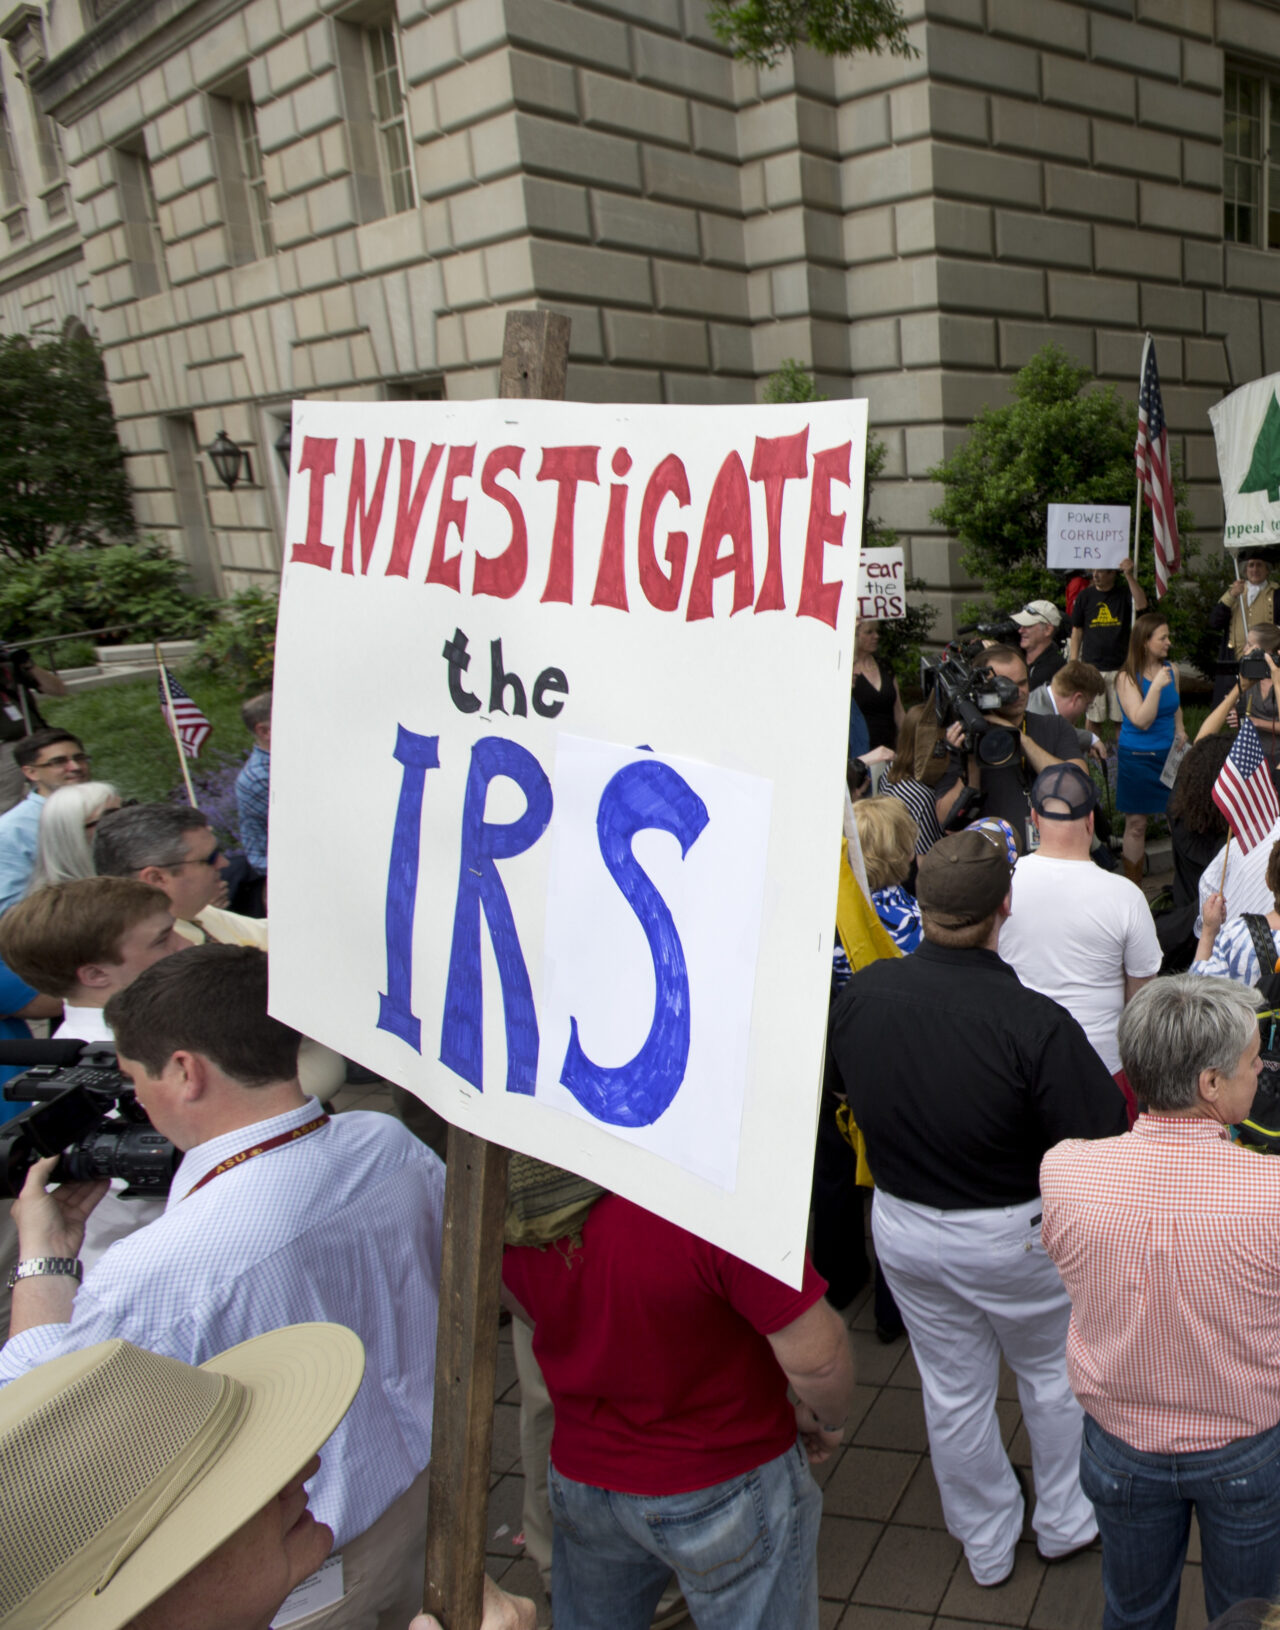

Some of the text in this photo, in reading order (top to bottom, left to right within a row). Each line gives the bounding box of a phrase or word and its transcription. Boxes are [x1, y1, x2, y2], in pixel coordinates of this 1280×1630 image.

[1067, 511, 1111, 524] POWER
[1060, 529, 1125, 542] CORRUPTS
[1226, 520, 1265, 539] ppeal
[1073, 546, 1101, 559] IRS
[865, 581, 897, 595] the
[442, 627, 570, 719] the
[375, 722, 711, 1129] IRS
[215, 1152, 247, 1174] ASU
